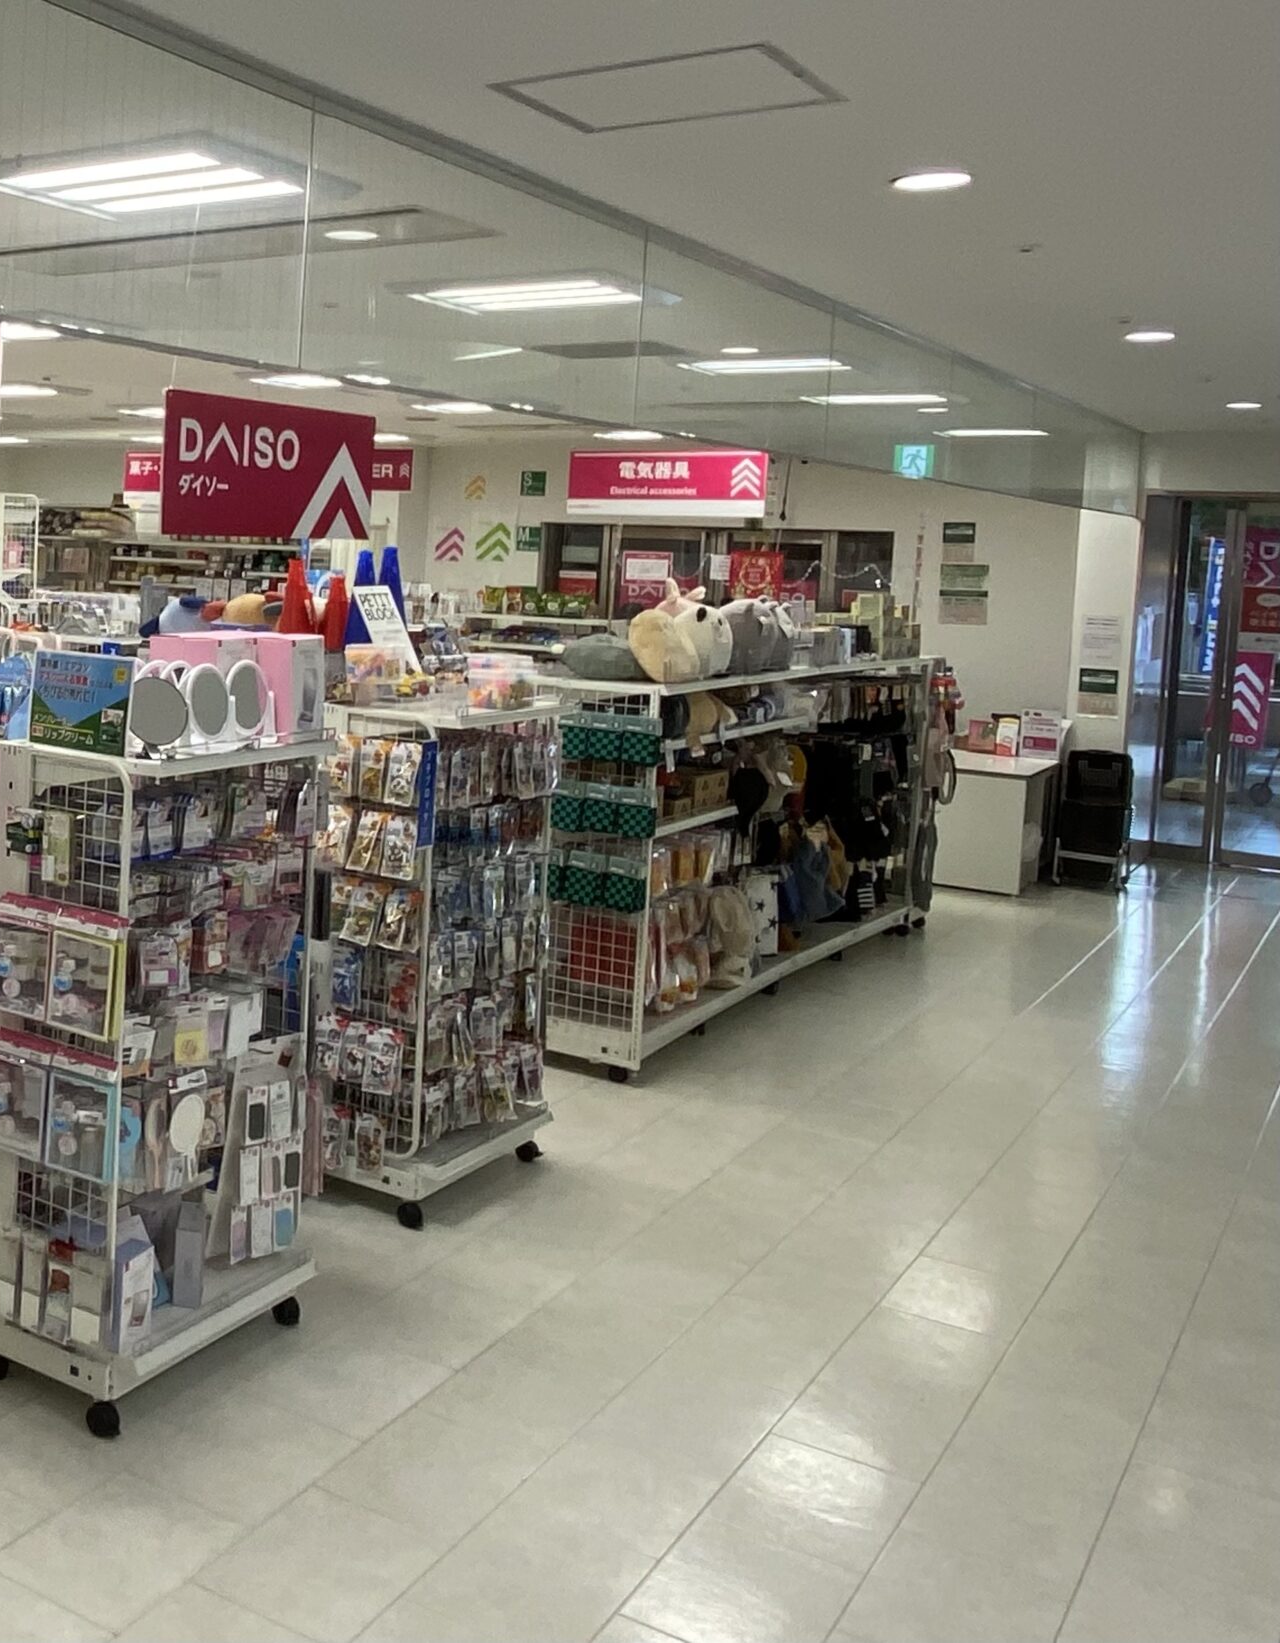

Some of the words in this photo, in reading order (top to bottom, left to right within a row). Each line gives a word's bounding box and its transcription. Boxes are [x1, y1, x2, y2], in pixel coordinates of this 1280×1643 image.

[178, 417, 301, 471] DAISO
[619, 461, 691, 480] 電気器具
[178, 473, 229, 496] ダイソー
[610, 486, 648, 496] Electrical
[358, 592, 393, 608] PETIT
[364, 608, 399, 621] BLOCK
